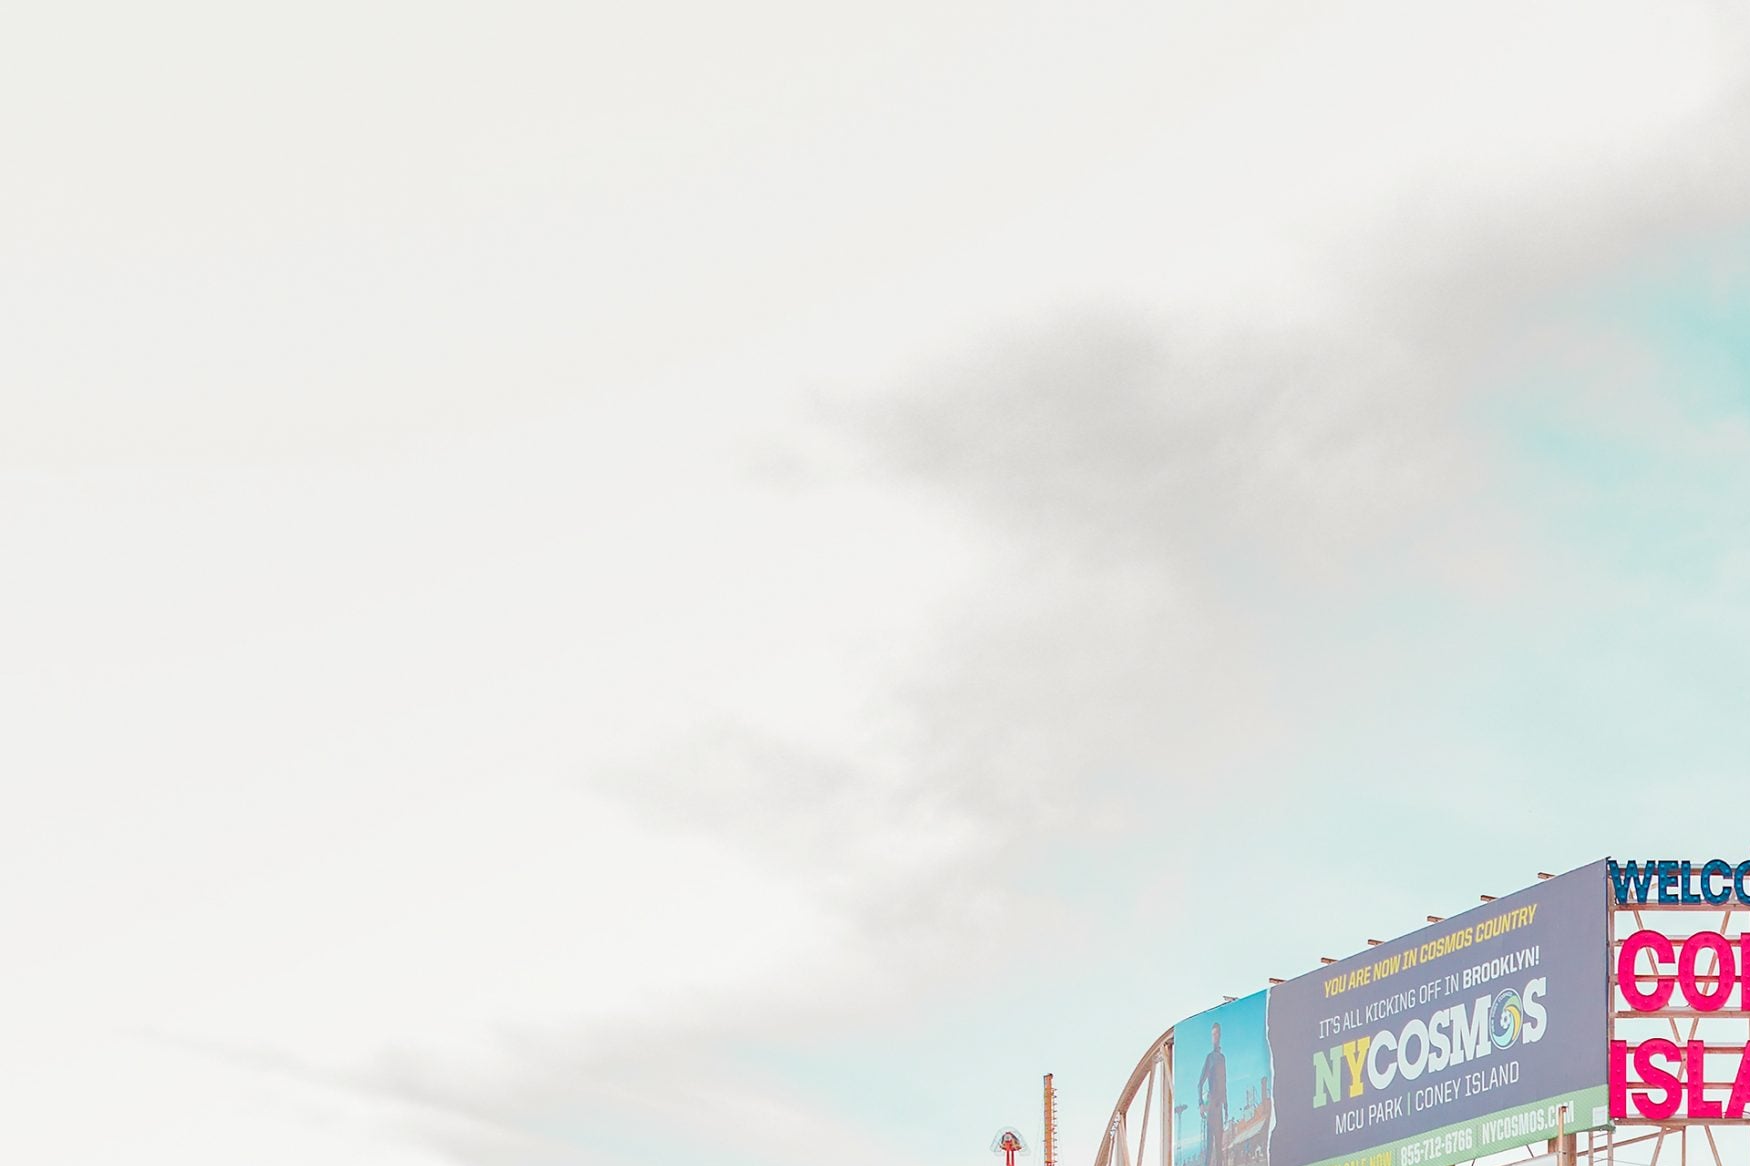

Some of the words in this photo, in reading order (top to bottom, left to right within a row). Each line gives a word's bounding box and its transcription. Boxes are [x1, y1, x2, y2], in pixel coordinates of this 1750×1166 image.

[1319, 1015, 1341, 1039] IT'S
[1343, 1009, 1364, 1032] ALL
[1365, 991, 1416, 1025] KICKING
[1419, 979, 1442, 1004] OFF
[1444, 974, 1460, 996] IN
[1462, 945, 1540, 989] BROOKLYN!
[1324, 977, 1347, 999] YOU
[1348, 969, 1371, 991] ARE
[1373, 957, 1402, 981] NOW
[1402, 952, 1418, 970] IN
[1420, 927, 1473, 964] COSMOS
[1475, 903, 1538, 944] COUNTRY
[1335, 1110, 1365, 1135] MCU
[1368, 1102, 1403, 1127] PARK
[1415, 1078, 1461, 1111] CONEY
[1465, 1060, 1520, 1097] ISLAND
